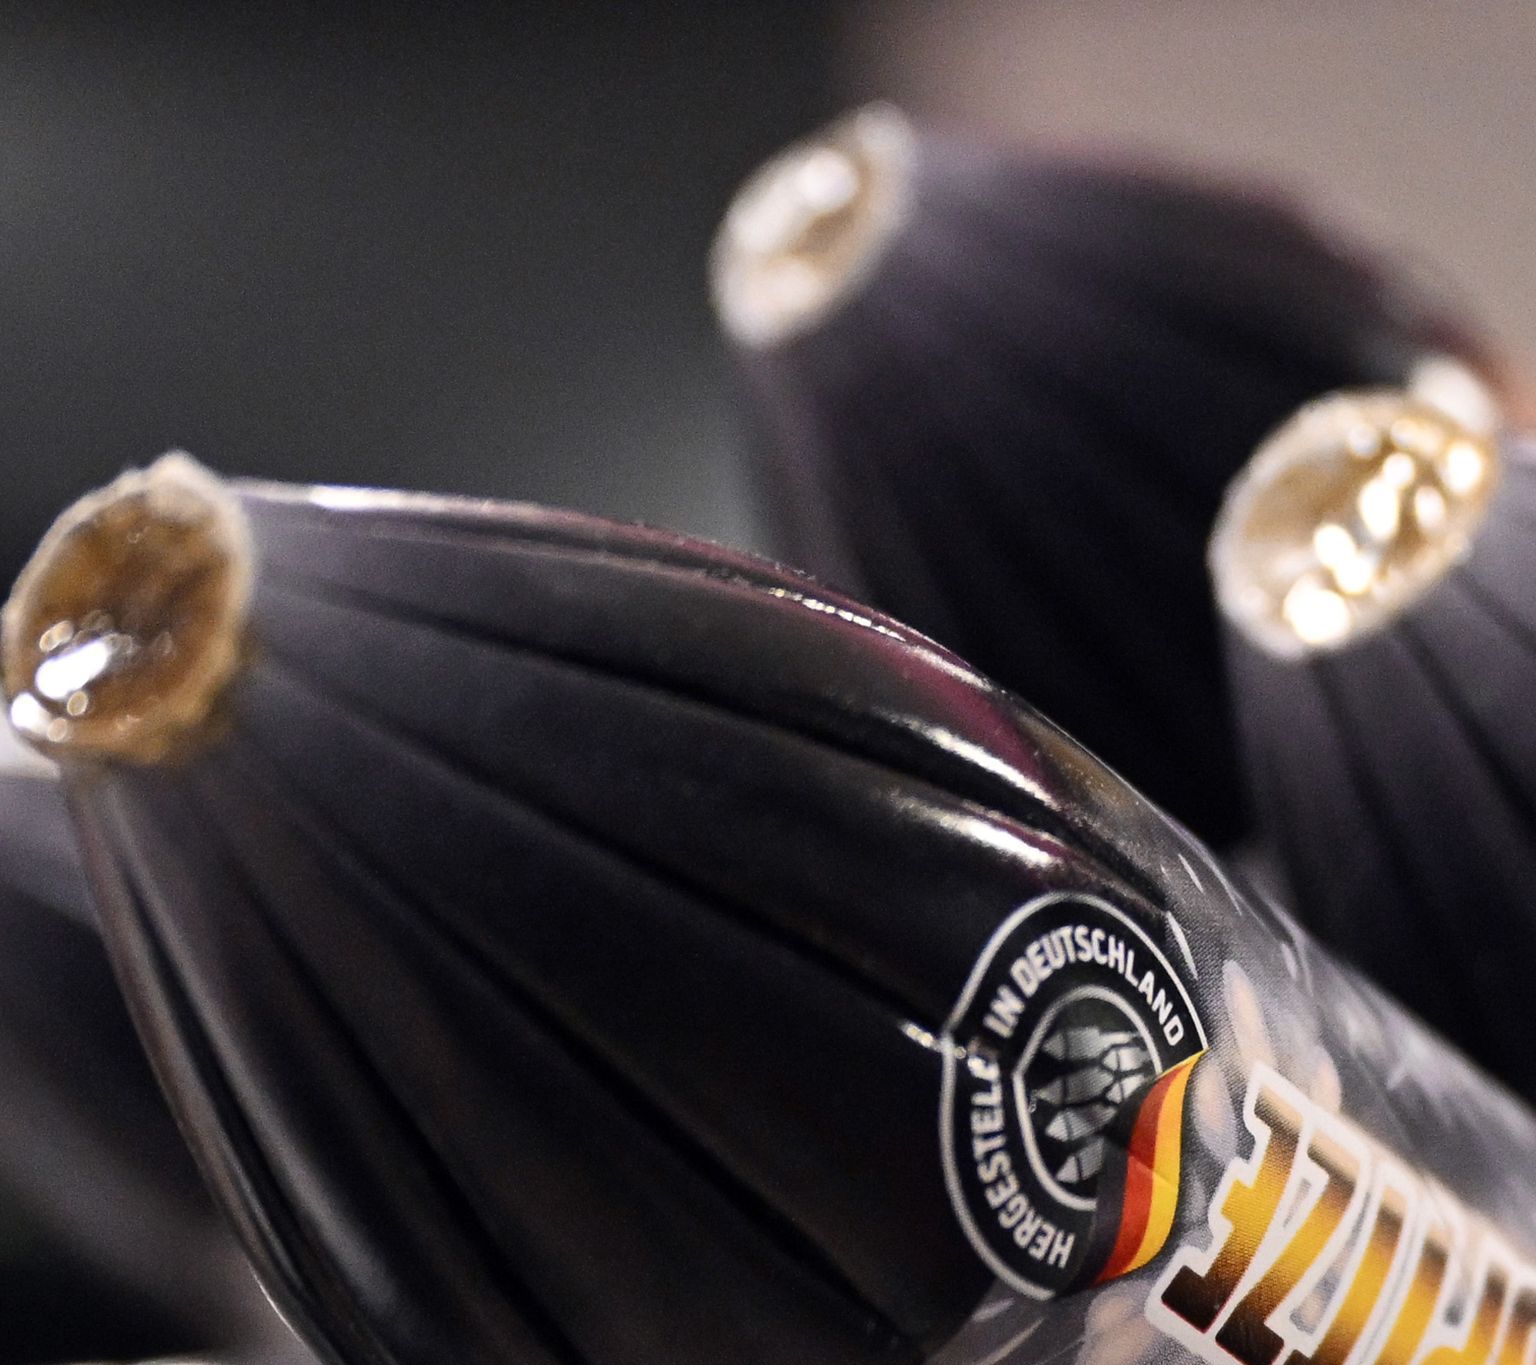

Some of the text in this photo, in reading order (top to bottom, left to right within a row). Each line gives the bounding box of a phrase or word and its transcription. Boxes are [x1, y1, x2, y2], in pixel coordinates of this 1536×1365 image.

[969, 925, 1184, 1268] HERGESTELL IN DEUTSCHLAND
